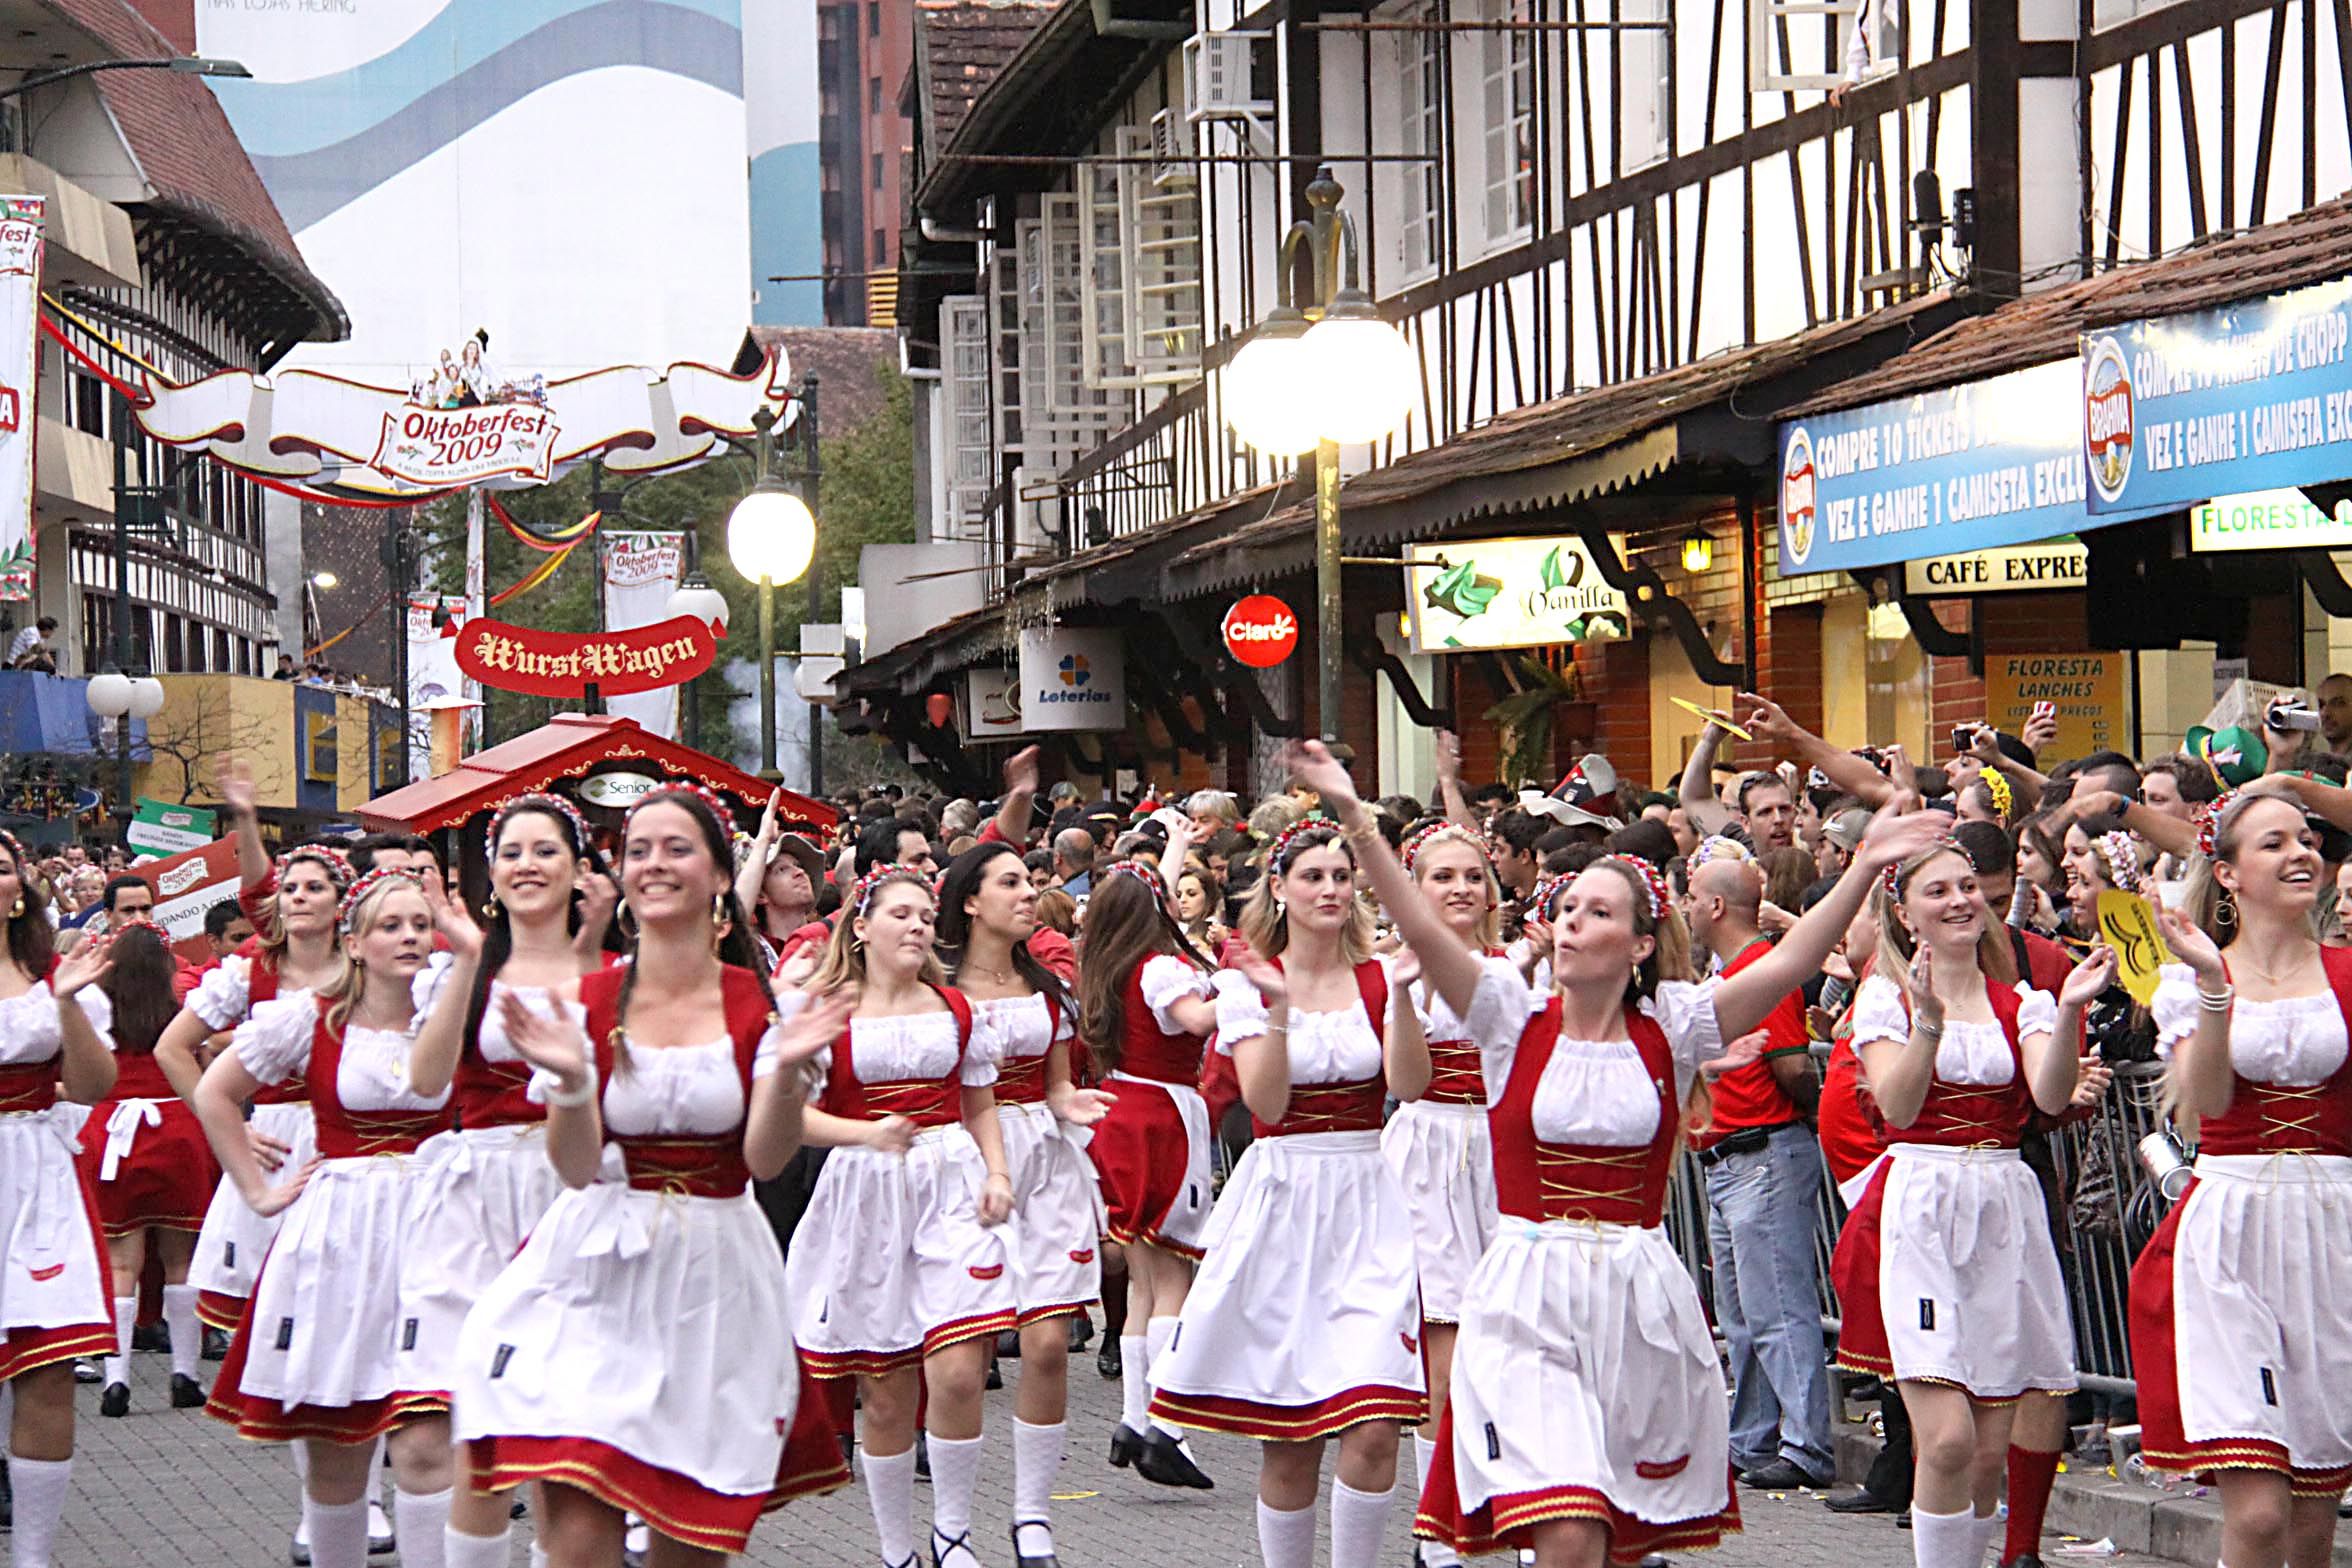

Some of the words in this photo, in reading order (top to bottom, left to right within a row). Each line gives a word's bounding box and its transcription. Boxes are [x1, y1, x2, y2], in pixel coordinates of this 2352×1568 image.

[2296, 311, 2348, 370] CHOPP
[403, 408, 548, 443] Oktoberfest
[2089, 392, 2131, 442] BRAHMA
[427, 432, 503, 467] 2009
[1816, 426, 1878, 480] COMPRE
[1883, 422, 1901, 467] 10
[1906, 405, 1970, 462] TICKETS
[2144, 423, 2172, 472] VEZ
[2175, 421, 2185, 468] E
[2186, 412, 2237, 467] GANHE
[2240, 410, 2249, 457] 1
[2252, 396, 2325, 456] CAMISETA
[1826, 498, 1856, 544] VEZ
[1858, 495, 1869, 538] E
[1871, 484, 1928, 537] GANHE
[1934, 481, 1942, 526] 1
[1948, 464, 2031, 523] CAMISETA
[2034, 453, 2087, 508] EXCLU
[2202, 502, 2332, 534] FLORESTA
[616, 551, 676, 569] Oktoberfest
[629, 561, 658, 577] 2009
[1926, 555, 1989, 585] CAFÉ
[1528, 585, 1614, 617] Vanilla
[1228, 617, 1292, 641] Claro
[2007, 658, 2104, 677] FLORESTA
[1039, 689, 1112, 704] Loterias
[2018, 681, 2095, 698] LANCHES
[609, 781, 652, 794] Senior
[162, 860, 203, 884] Oktoberfest
